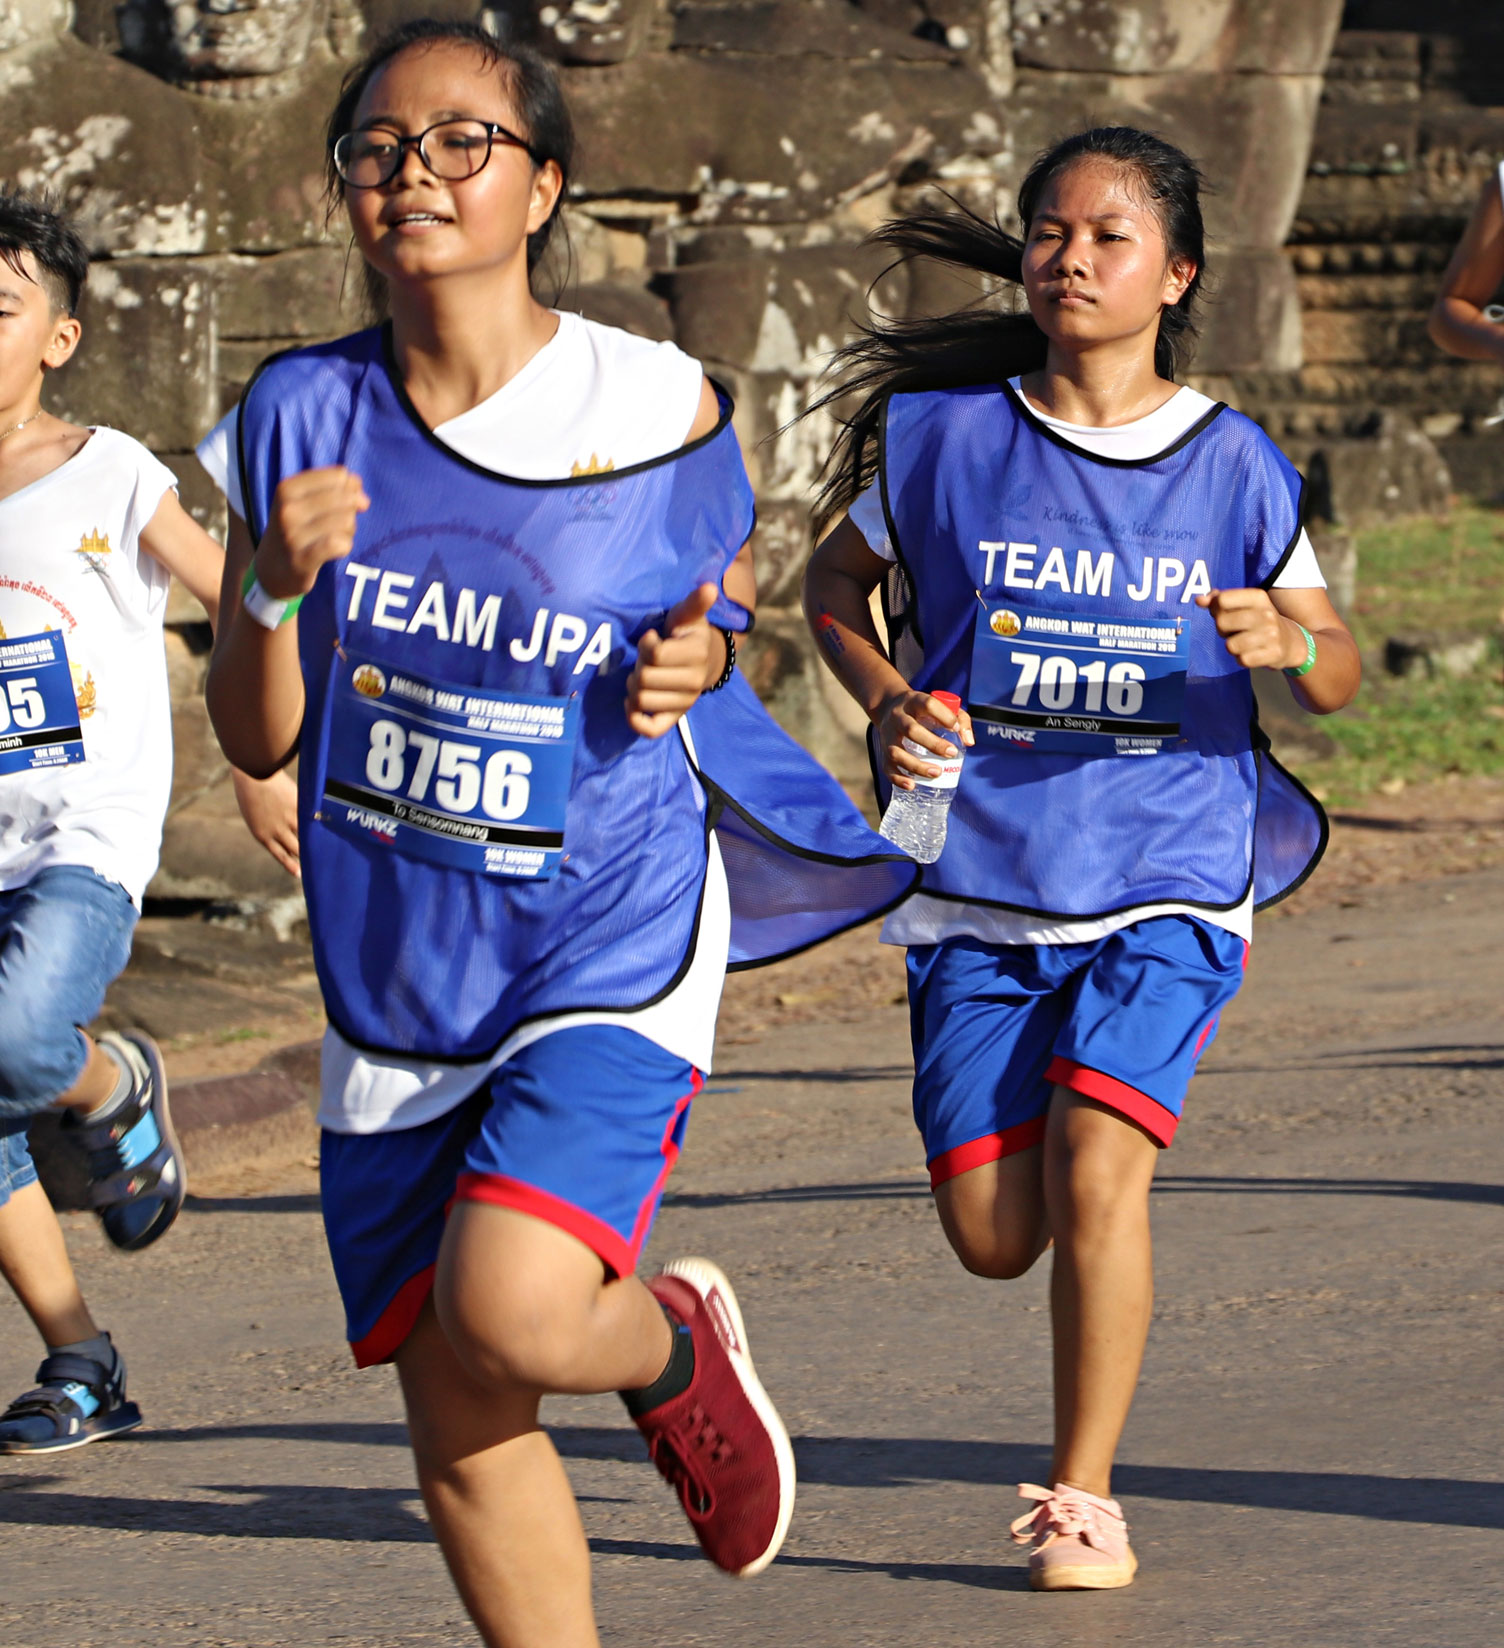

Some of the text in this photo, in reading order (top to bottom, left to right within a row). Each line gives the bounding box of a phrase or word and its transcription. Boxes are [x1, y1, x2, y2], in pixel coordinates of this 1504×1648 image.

[979, 540, 1212, 603] TEAM JPA
[345, 562, 612, 676] TEAM JPA
[1025, 616, 1177, 641] ANGKOR WAT INTERNATIONAL
[1117, 640, 1157, 652] MARATHON
[1011, 651, 1146, 716] 7016
[464, 696, 565, 724] INTERNATIONAL
[1046, 716, 1101, 731] An Sengly
[1115, 737, 1162, 748] 10K WOMEN
[366, 719, 532, 821] 8756
